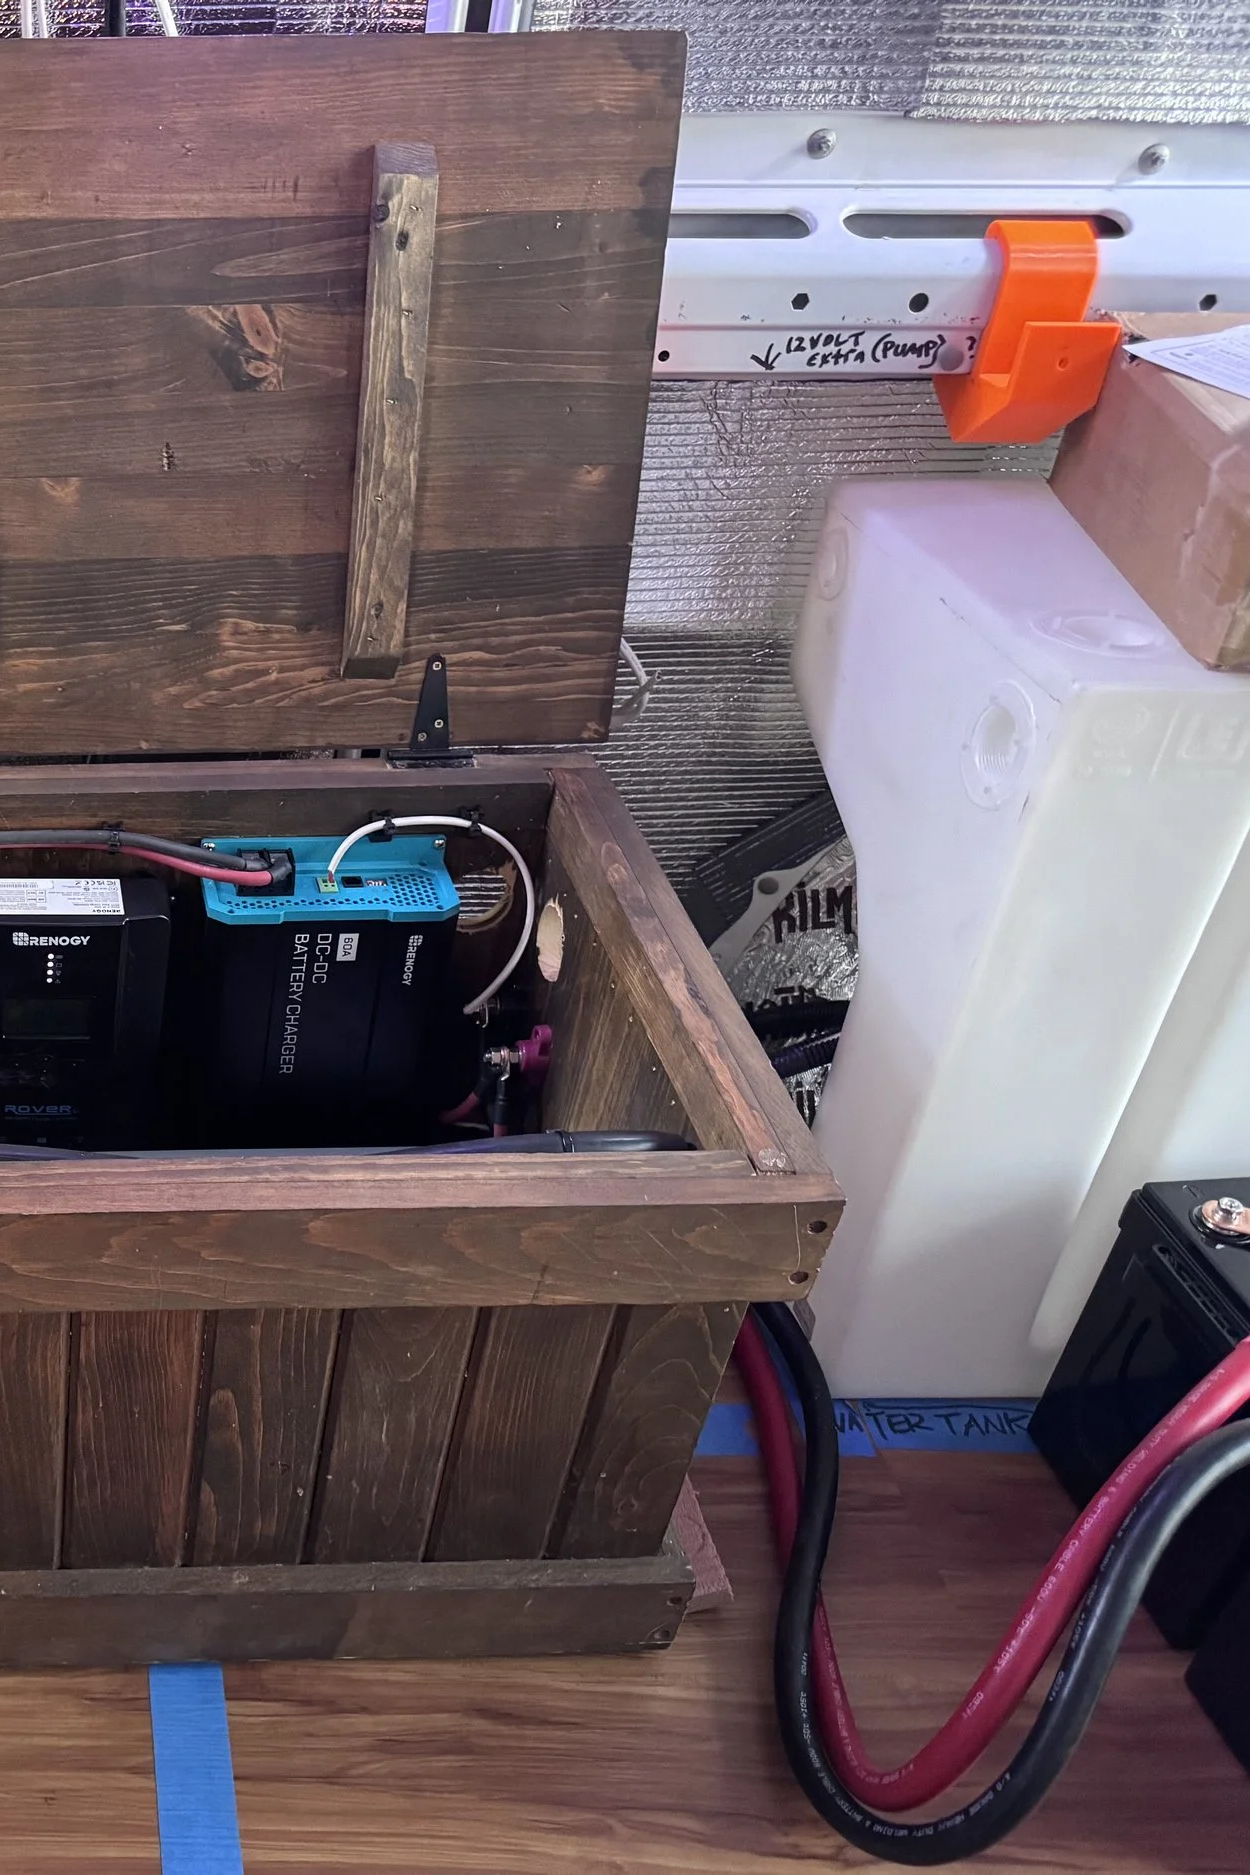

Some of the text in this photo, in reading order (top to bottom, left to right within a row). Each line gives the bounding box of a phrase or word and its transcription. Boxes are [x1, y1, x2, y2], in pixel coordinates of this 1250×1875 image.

[29, 936, 91, 946] RENOGY
[341, 936, 354, 958] 60A
[312, 933, 332, 984] DC-DC
[402, 946, 417, 986] RENOGY
[279, 934, 310, 1074] BATTERY CHARGER
[4, 1104, 72, 1115] ROVER
[934, 1410, 1030, 1437] TANK
[1076, 1493, 1109, 1538] BATTERY
[1053, 1538, 1079, 1572] CABLE
